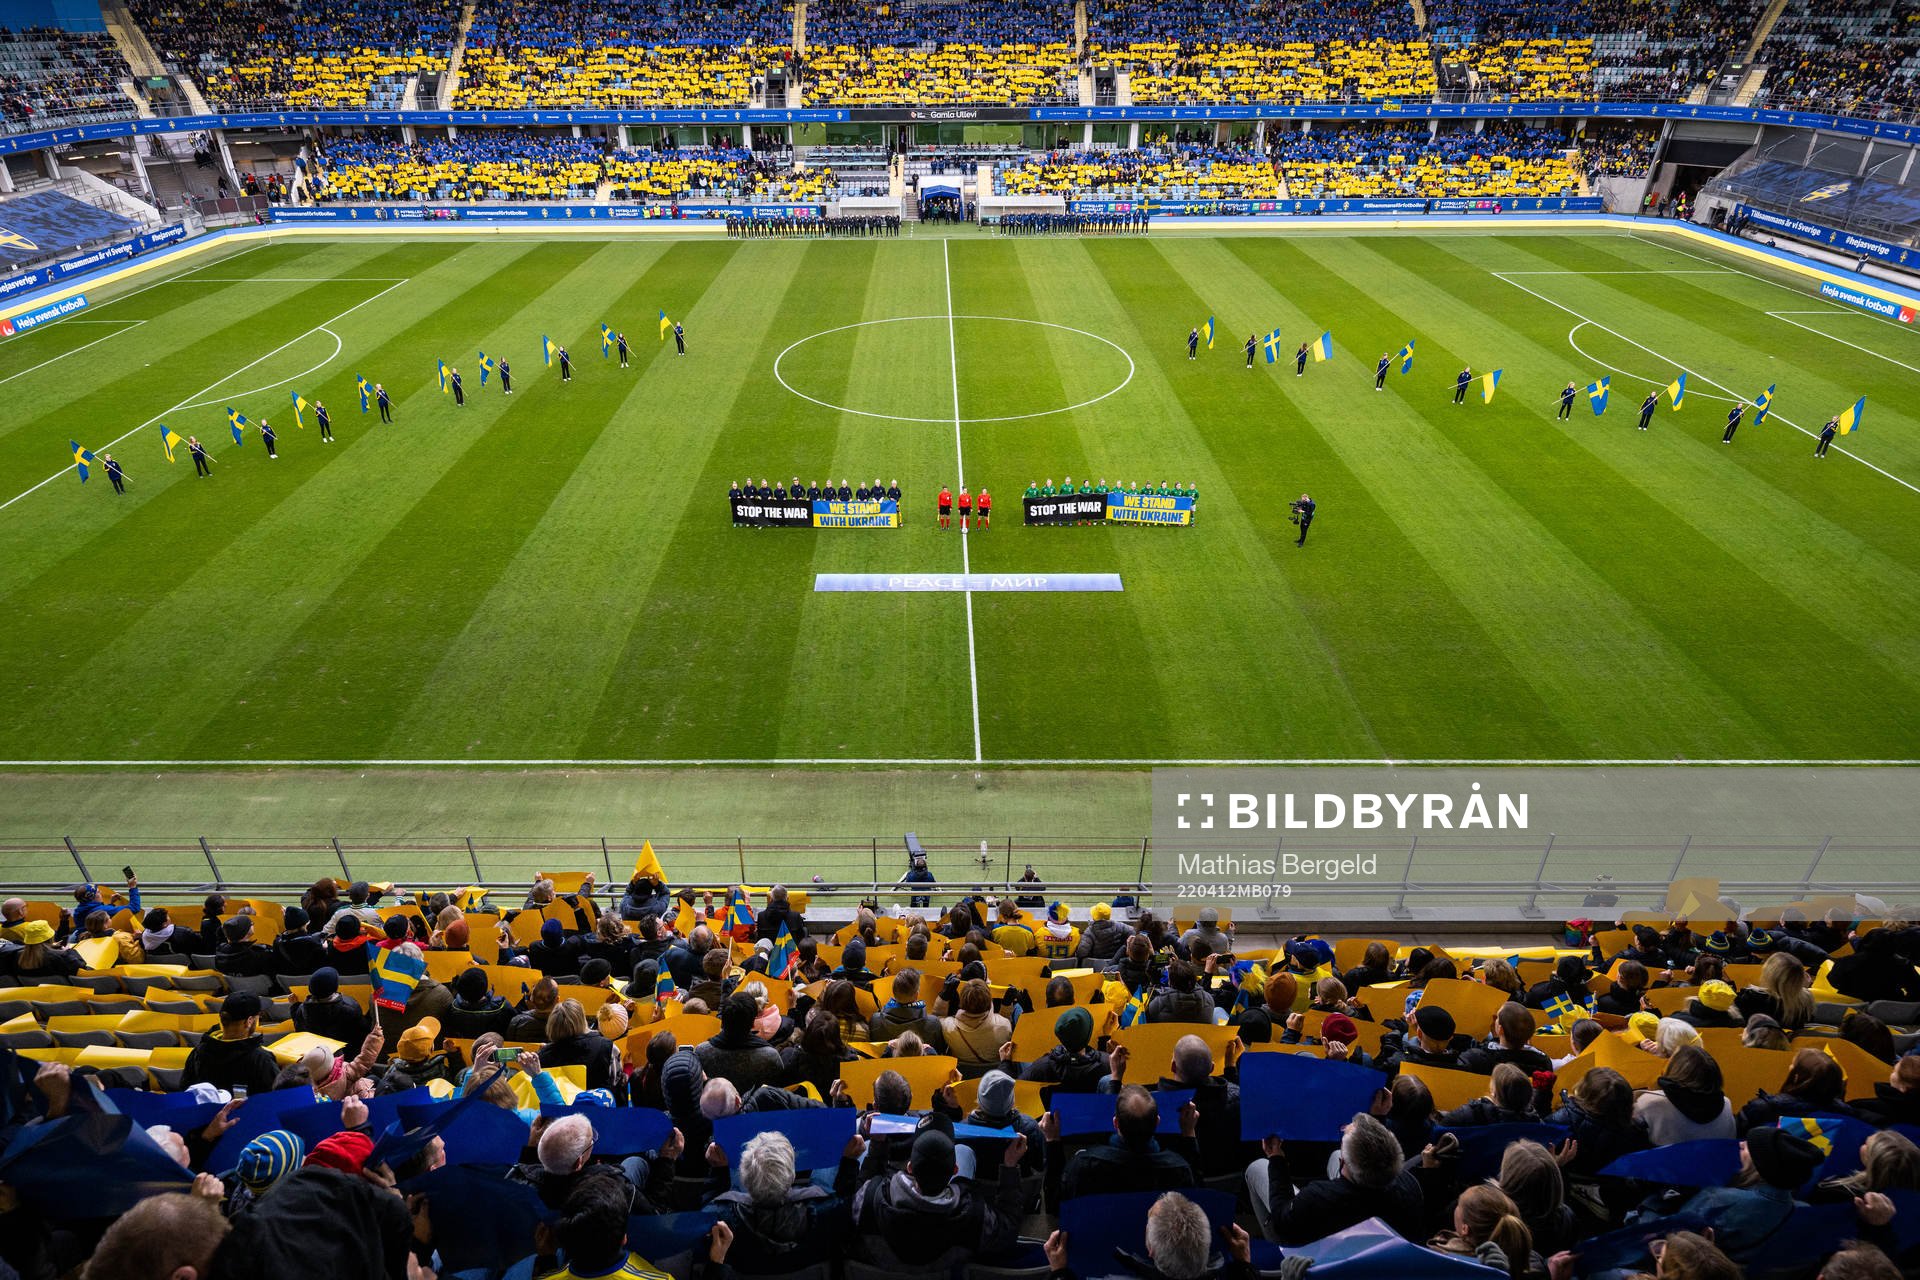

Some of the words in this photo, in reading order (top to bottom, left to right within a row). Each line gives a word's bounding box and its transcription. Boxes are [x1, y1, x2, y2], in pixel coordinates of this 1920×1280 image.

[956, 110, 976, 118] Ullevi
[1750, 210, 1785, 226] Tillsammans
[1798, 222, 1821, 236] Sverige
[152, 228, 183, 242] #hejasverige
[1846, 236, 1890, 255] #hejasverige
[60, 255, 99, 272] Tillsammans
[98, 252, 106, 260] är
[106, 249, 112, 258] vi
[111, 244, 132, 255] Sverige
[1822, 285, 1839, 296] Heja
[1839, 292, 1865, 305] svensk
[1865, 298, 1895, 315] fotboll!
[16, 316, 36, 328] Heja
[35, 307, 61, 322] svensk
[60, 297, 85, 313] fotboll!
[829, 502, 846, 514] WE
[848, 502, 881, 514] STAND
[1030, 504, 1056, 516] STOP
[1058, 502, 1077, 514] THE
[1077, 501, 1102, 512] WAR
[1124, 495, 1141, 508] WE
[1142, 497, 1176, 509] STAND
[737, 505, 762, 518] STOP
[763, 506, 782, 518] THE
[783, 507, 808, 519] WAR
[1112, 508, 1139, 520] WITH
[1141, 510, 1184, 523] UKRAINE
[820, 516, 846, 526] WITH
[848, 515, 891, 526] UKRAINE
[888, 577, 964, 588] PEACE
